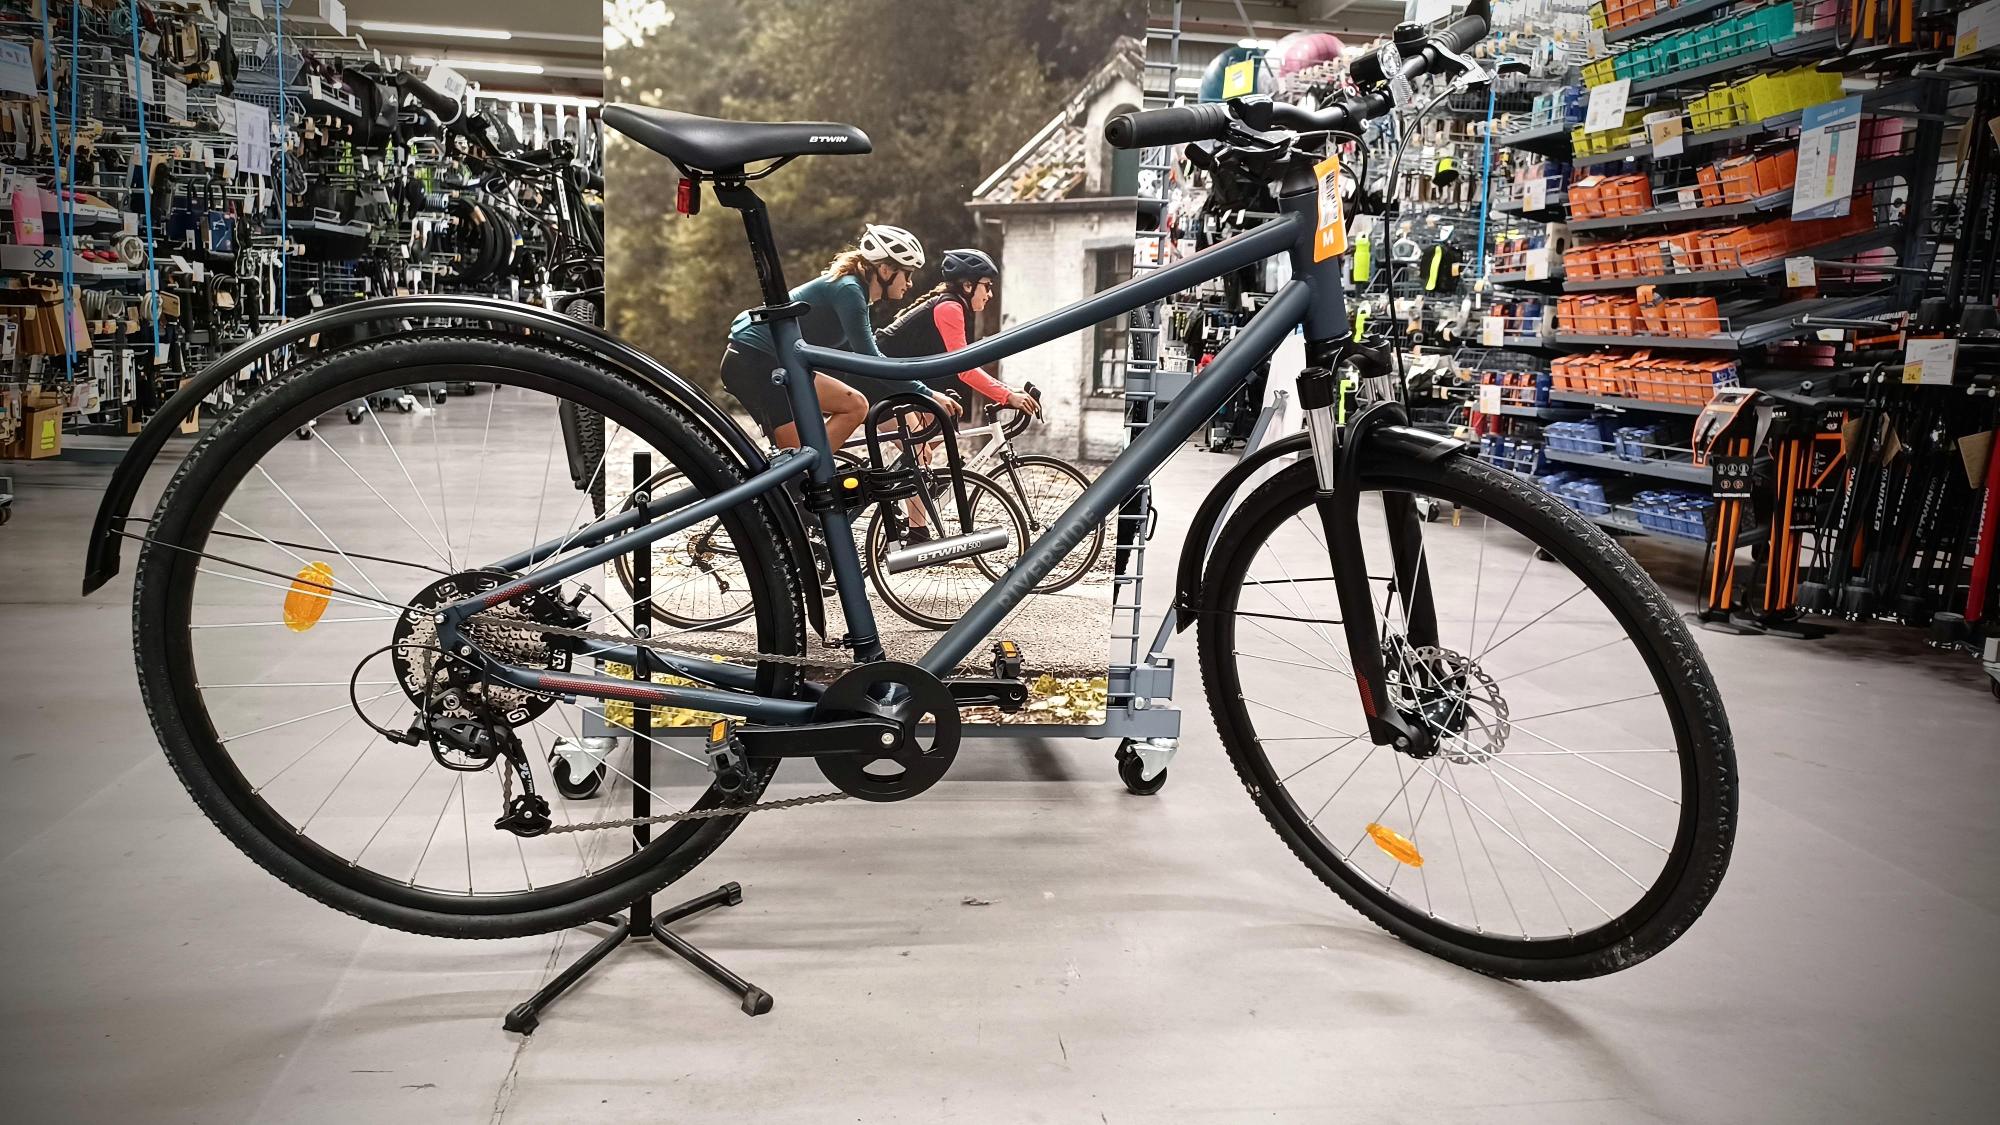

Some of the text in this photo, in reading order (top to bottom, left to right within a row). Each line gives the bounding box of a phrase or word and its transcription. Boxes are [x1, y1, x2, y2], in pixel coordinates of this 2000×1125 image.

[1322, 228, 1335, 248] M
[917, 540, 981, 562] BTWIN 500
